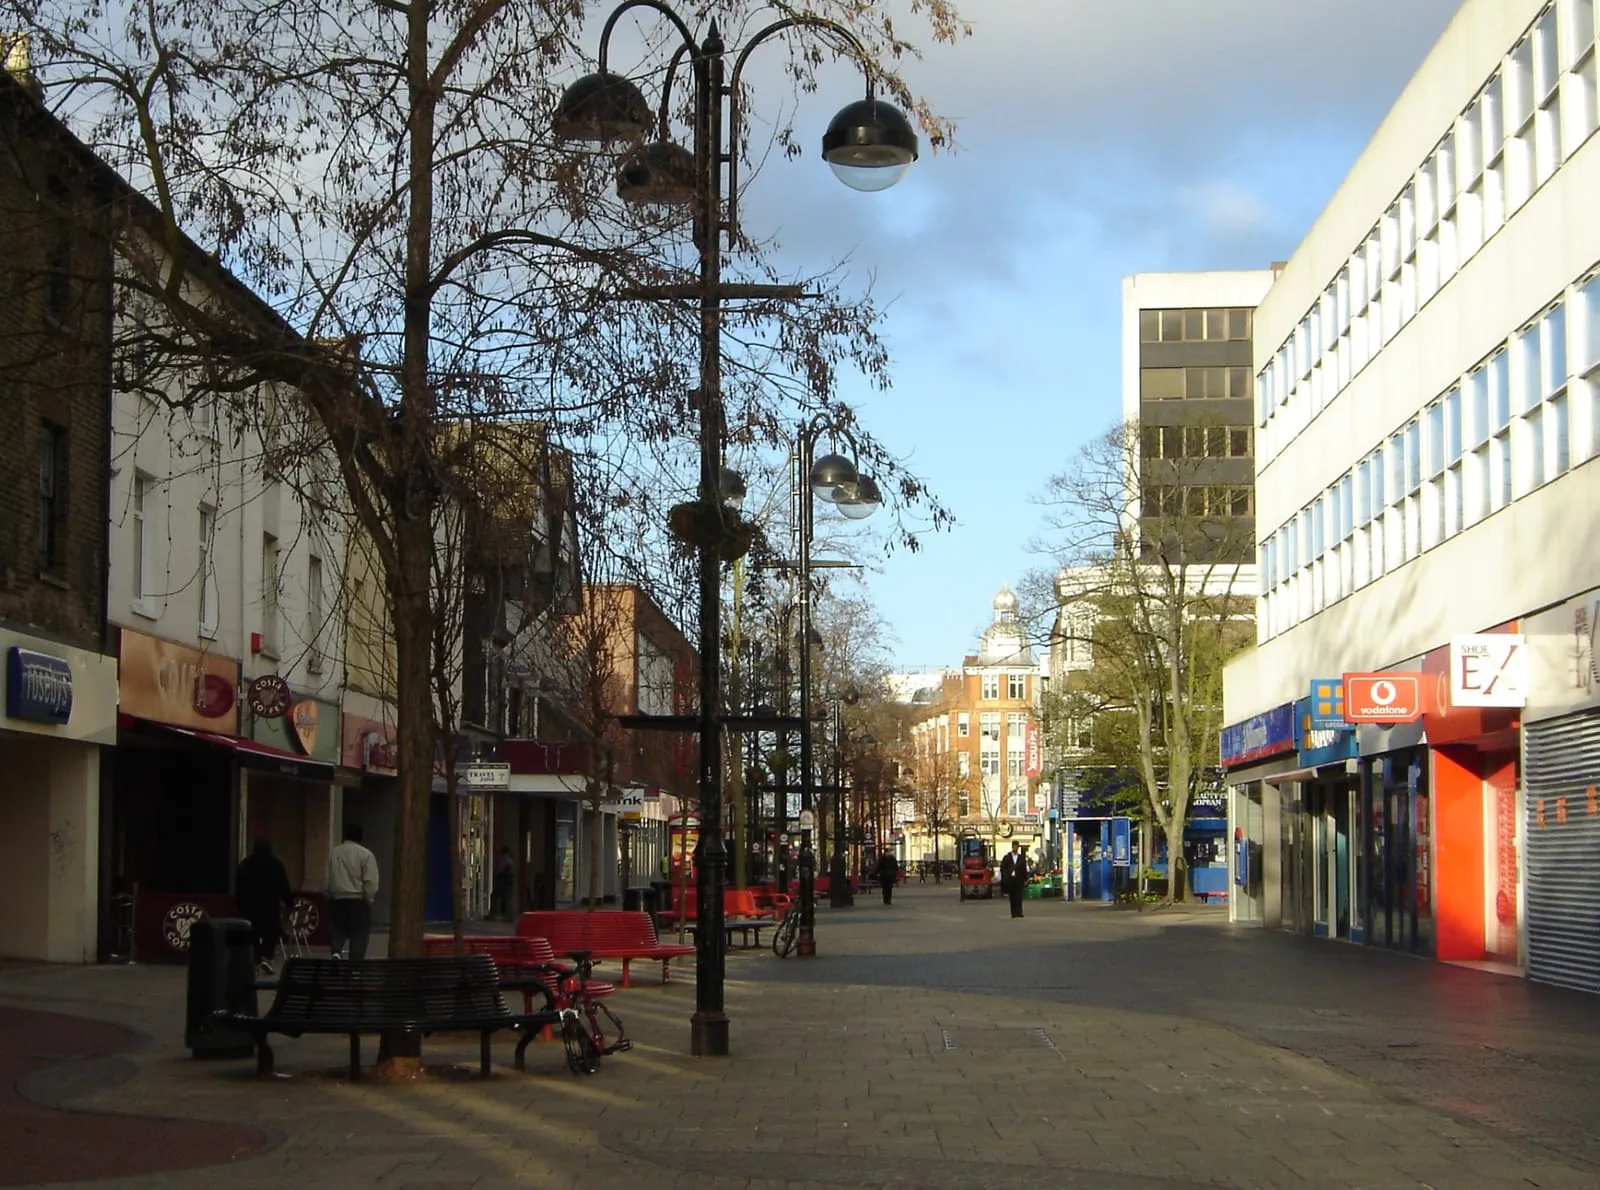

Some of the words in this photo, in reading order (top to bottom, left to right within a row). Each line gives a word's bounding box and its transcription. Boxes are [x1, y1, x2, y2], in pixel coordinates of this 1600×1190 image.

[1460, 644, 1489, 654] SHOE
[24, 667, 69, 714] rosebys
[255, 679, 283, 691] COSTA
[253, 700, 285, 715] COFEE
[1360, 706, 1407, 715] vodafone
[170, 904, 203, 919] COSTA
